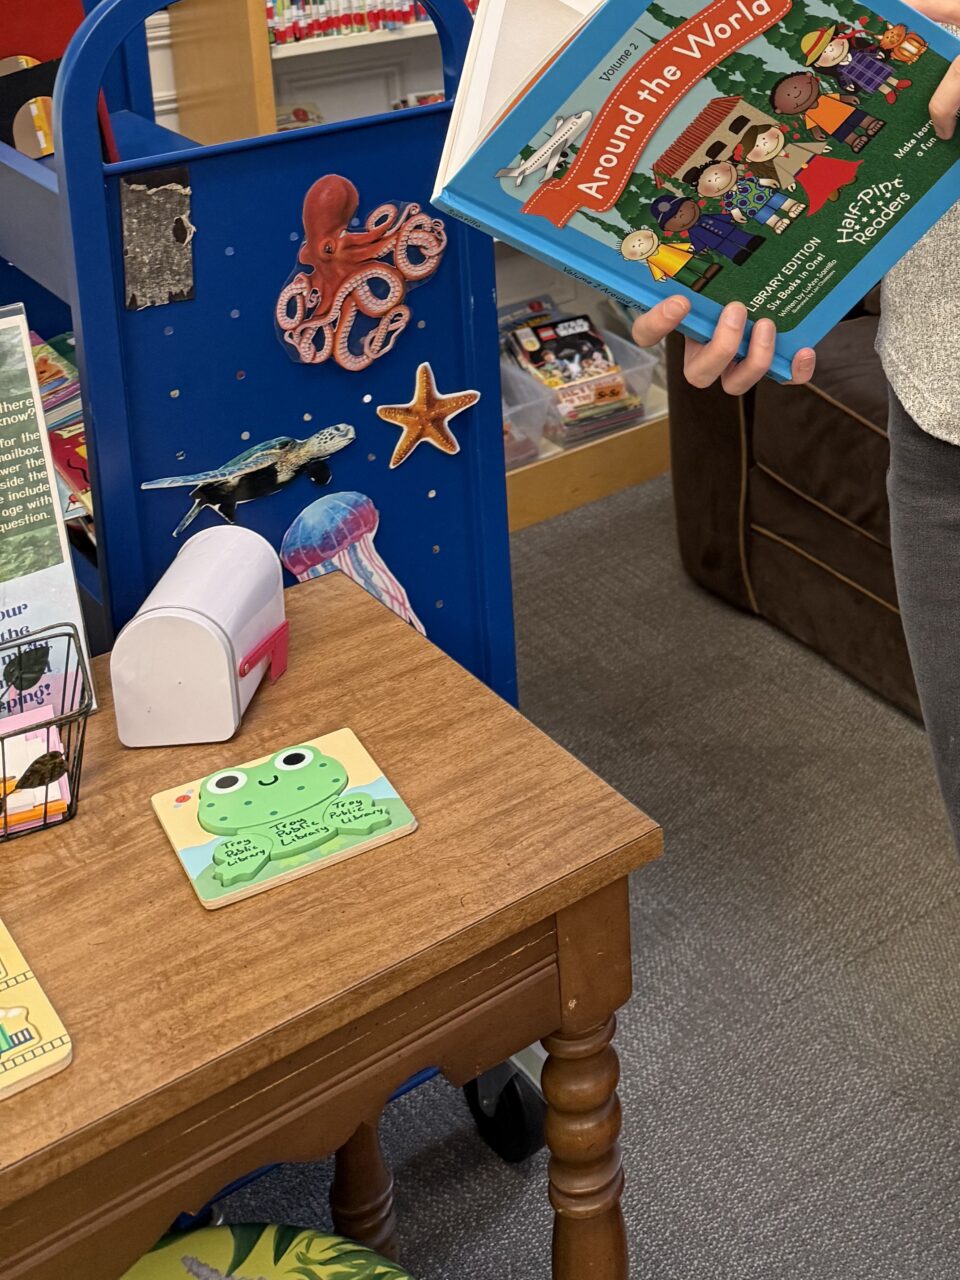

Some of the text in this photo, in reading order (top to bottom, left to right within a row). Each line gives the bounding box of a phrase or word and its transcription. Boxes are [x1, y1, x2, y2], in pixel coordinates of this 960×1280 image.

[598, 42, 639, 82] Volume 2
[577, 104, 646, 199] Around
[637, 65, 682, 103] the
[893, 138, 917, 159] Make
[920, 137, 937, 151] fun
[836, 177, 904, 243] Half-Pint
[852, 191, 911, 245] Readers
[746, 236, 822, 314] LIBRARY EDITION
[766, 300, 780, 311] Six
[779, 278, 801, 300] Books
[805, 252, 826, 271] One!
[562, 266, 594, 286] Volume
[600, 286, 632, 306] Around
[797, 292, 806, 303] by
[0, 397, 34, 414] there
[0, 431, 40, 448] for the
[26, 457, 45, 469] the
[28, 469, 48, 482] the
[8, 483, 50, 500] include
[2, 495, 53, 517] age with
[332, 799, 363, 809] Troy
[329, 807, 365, 819] Public
[341, 808, 384, 824] Library
[269, 818, 308, 831] Troy
[275, 821, 320, 837] Public
[221, 839, 251, 849] Troy
[280, 826, 330, 846] Library
[225, 846, 258, 858] Public
[227, 849, 266, 867] Library
